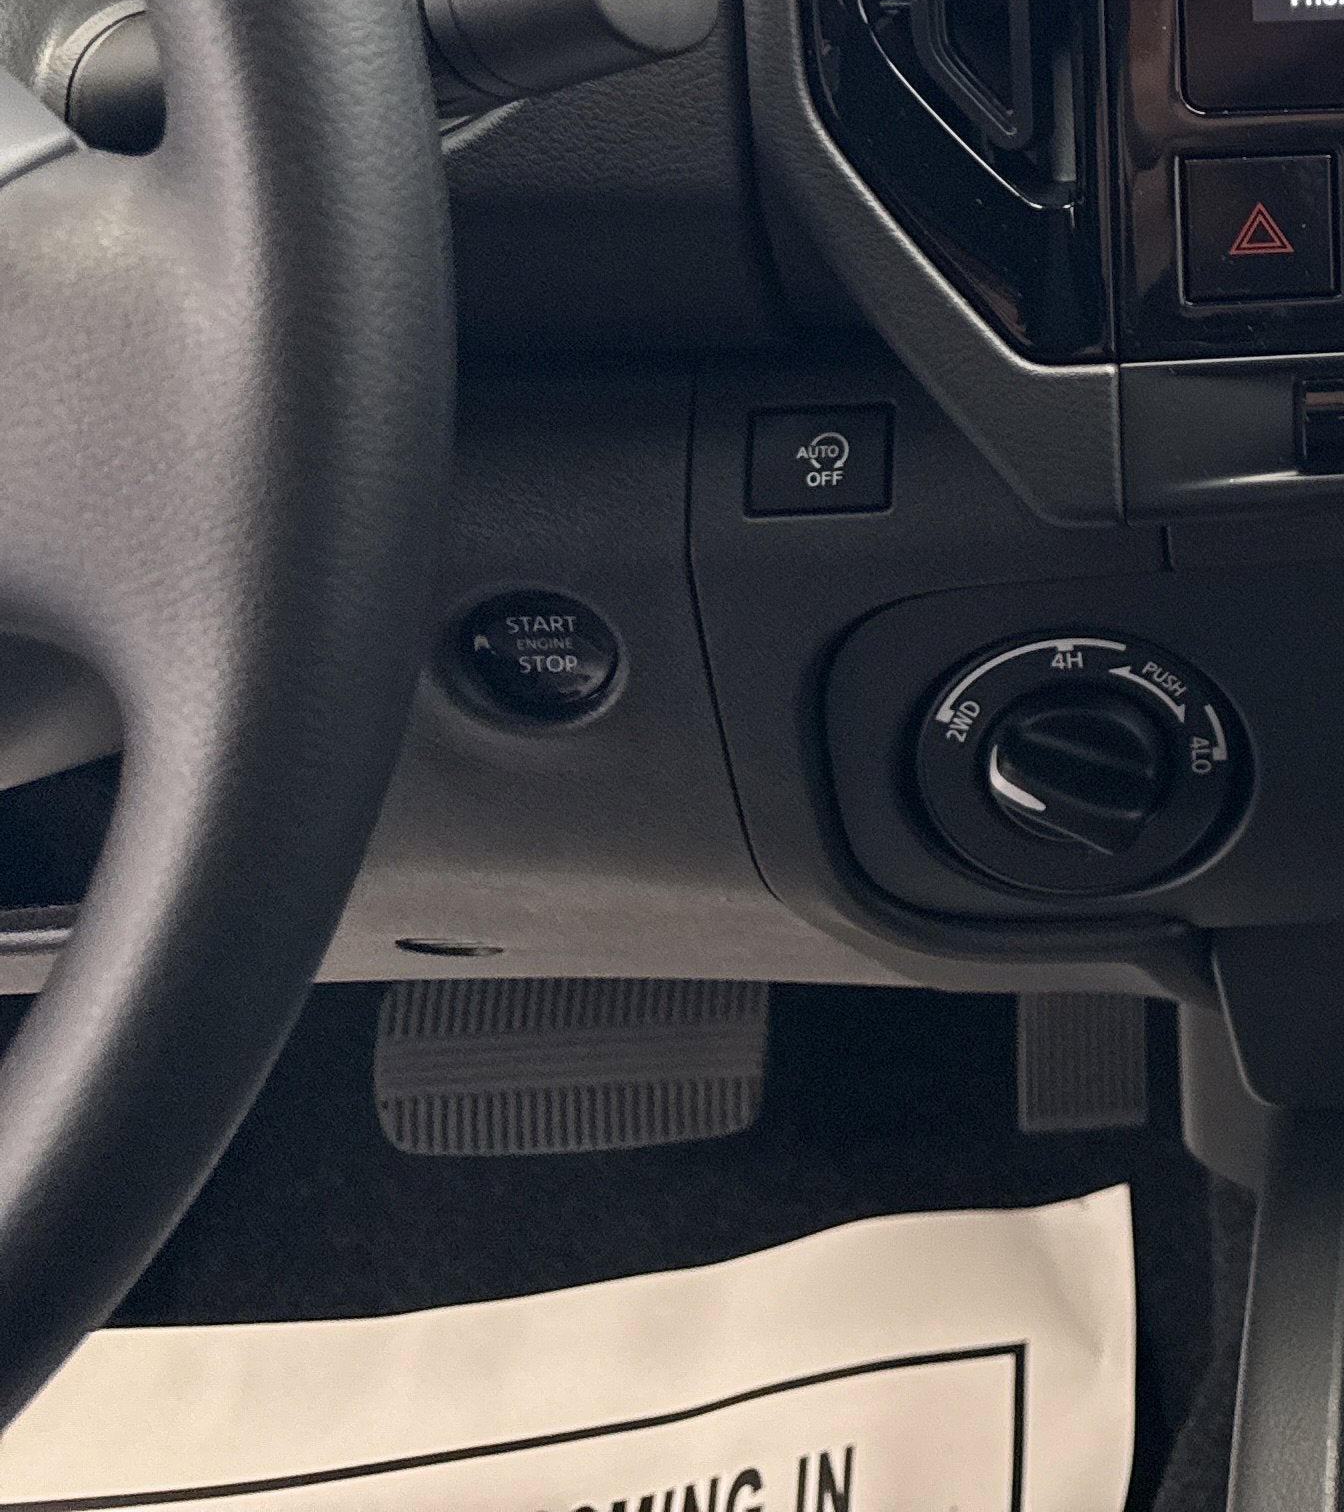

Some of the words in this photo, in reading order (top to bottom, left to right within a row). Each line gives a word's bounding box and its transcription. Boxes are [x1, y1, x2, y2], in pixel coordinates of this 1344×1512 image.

[797, 445, 839, 460] AUTO
[806, 470, 844, 487] OFF
[506, 616, 577, 635] START
[516, 637, 573, 650] ENGINE
[519, 655, 578, 673] STOP
[1051, 653, 1083, 670] 4H
[1142, 661, 1187, 698] PUSH
[946, 700, 981, 743] 2WD
[1189, 736, 1212, 775] 4LO
[796, 1444, 854, 1512] IN
